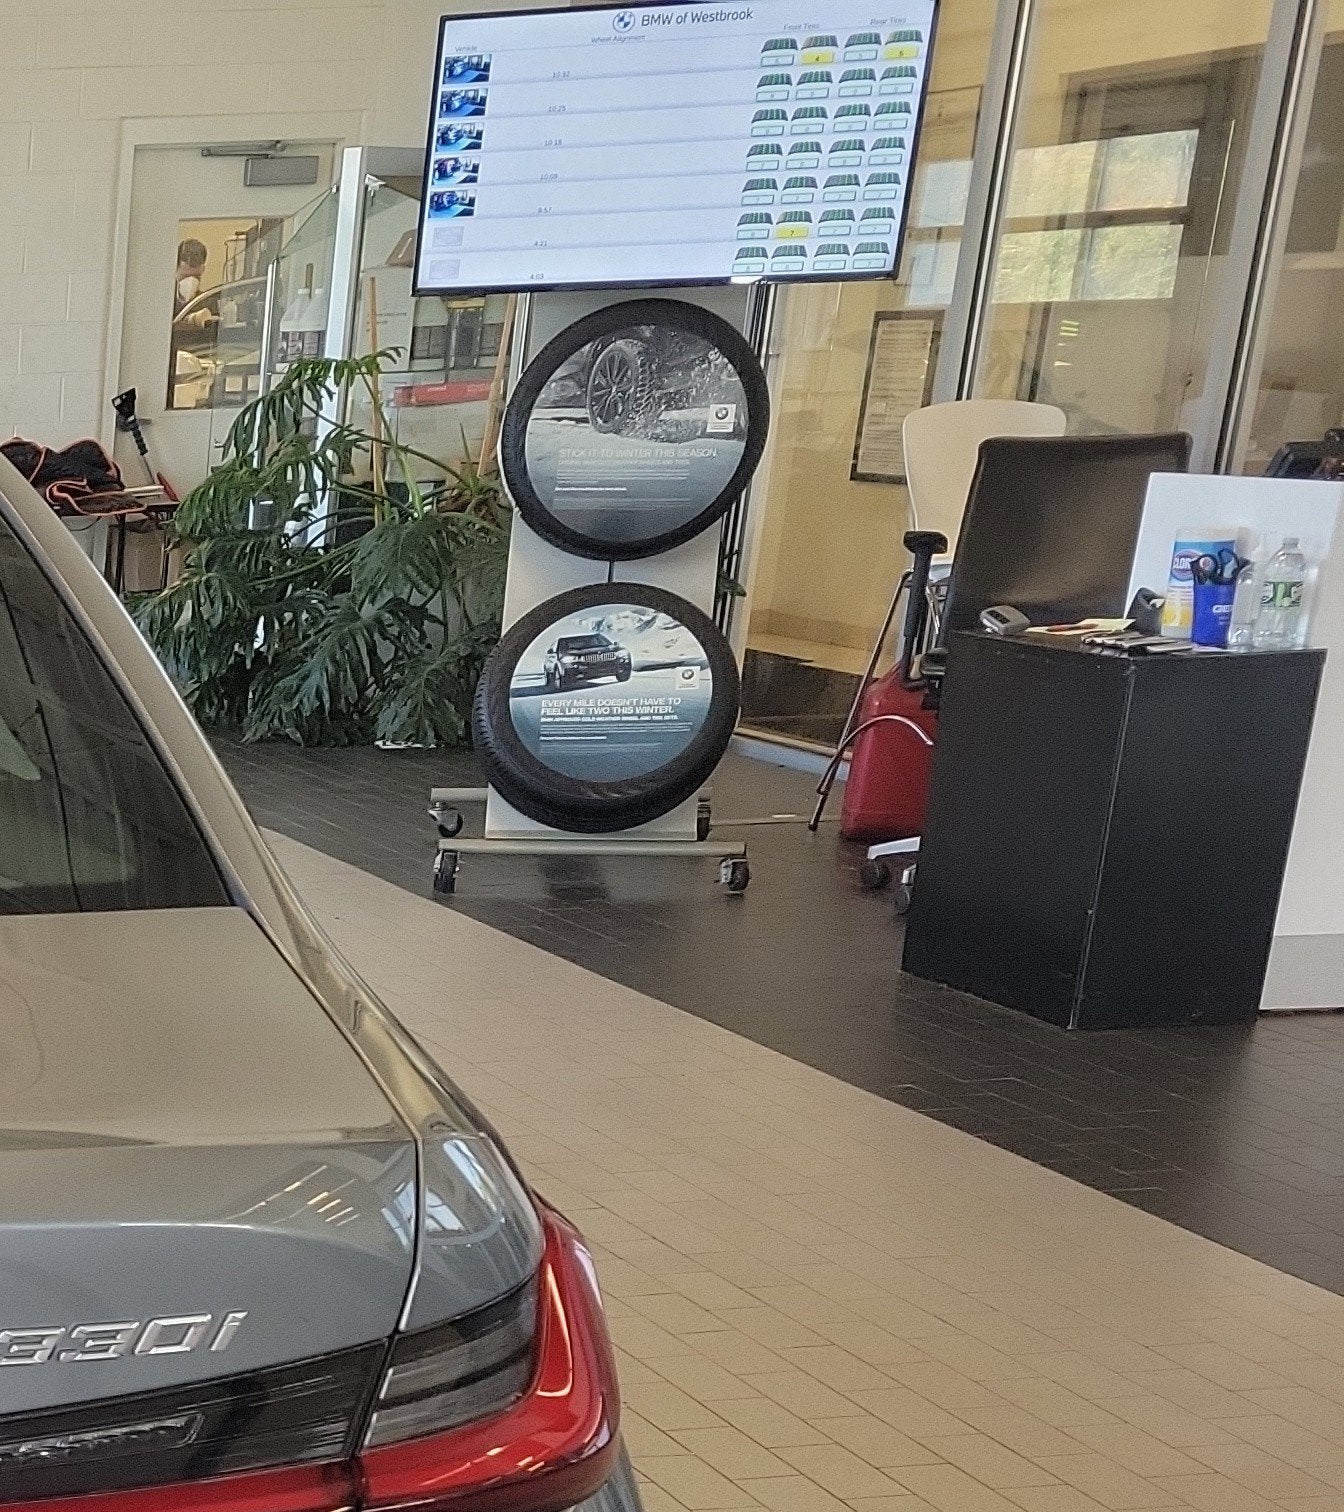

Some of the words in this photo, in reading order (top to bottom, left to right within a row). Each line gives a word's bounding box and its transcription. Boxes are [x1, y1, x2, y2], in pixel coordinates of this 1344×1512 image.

[641, 12, 673, 27] BMW
[675, 11, 688, 26] of
[690, 7, 754, 24] Westbrook
[1172, 556, 1192, 570] CLOR
[541, 699, 572, 708] EVERY
[573, 698, 595, 707] MILE
[639, 697, 667, 706] HAVE
[667, 697, 682, 705] TO
[540, 706, 564, 716] FEEL
[565, 706, 587, 715] LIKE
[587, 706, 611, 715] TWO
[612, 706, 634, 715] THIS
[635, 705, 675, 714] WINTER.
